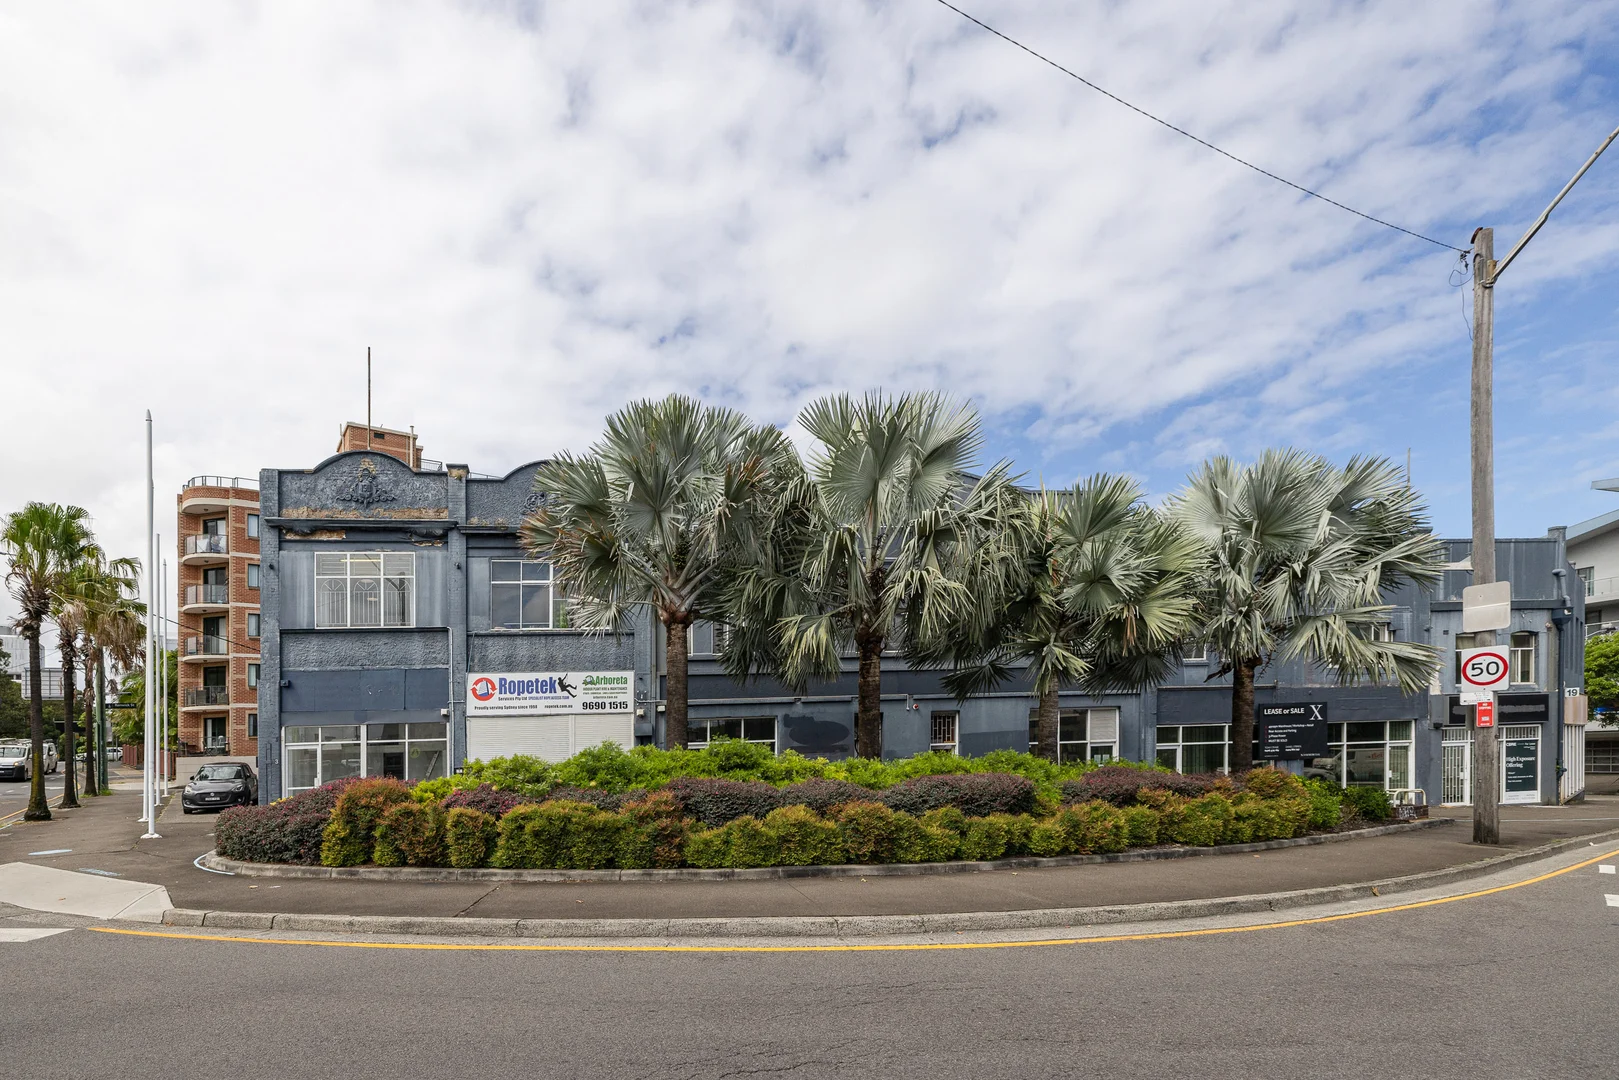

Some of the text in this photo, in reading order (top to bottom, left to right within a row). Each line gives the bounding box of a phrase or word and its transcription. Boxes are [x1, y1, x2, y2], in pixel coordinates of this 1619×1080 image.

[1471, 661, 1500, 677] 50
[498, 677, 557, 696] Ropetek
[596, 676, 628, 684] Arboreta
[582, 701, 628, 710] 9690 1515
[1310, 704, 1323, 720] X
